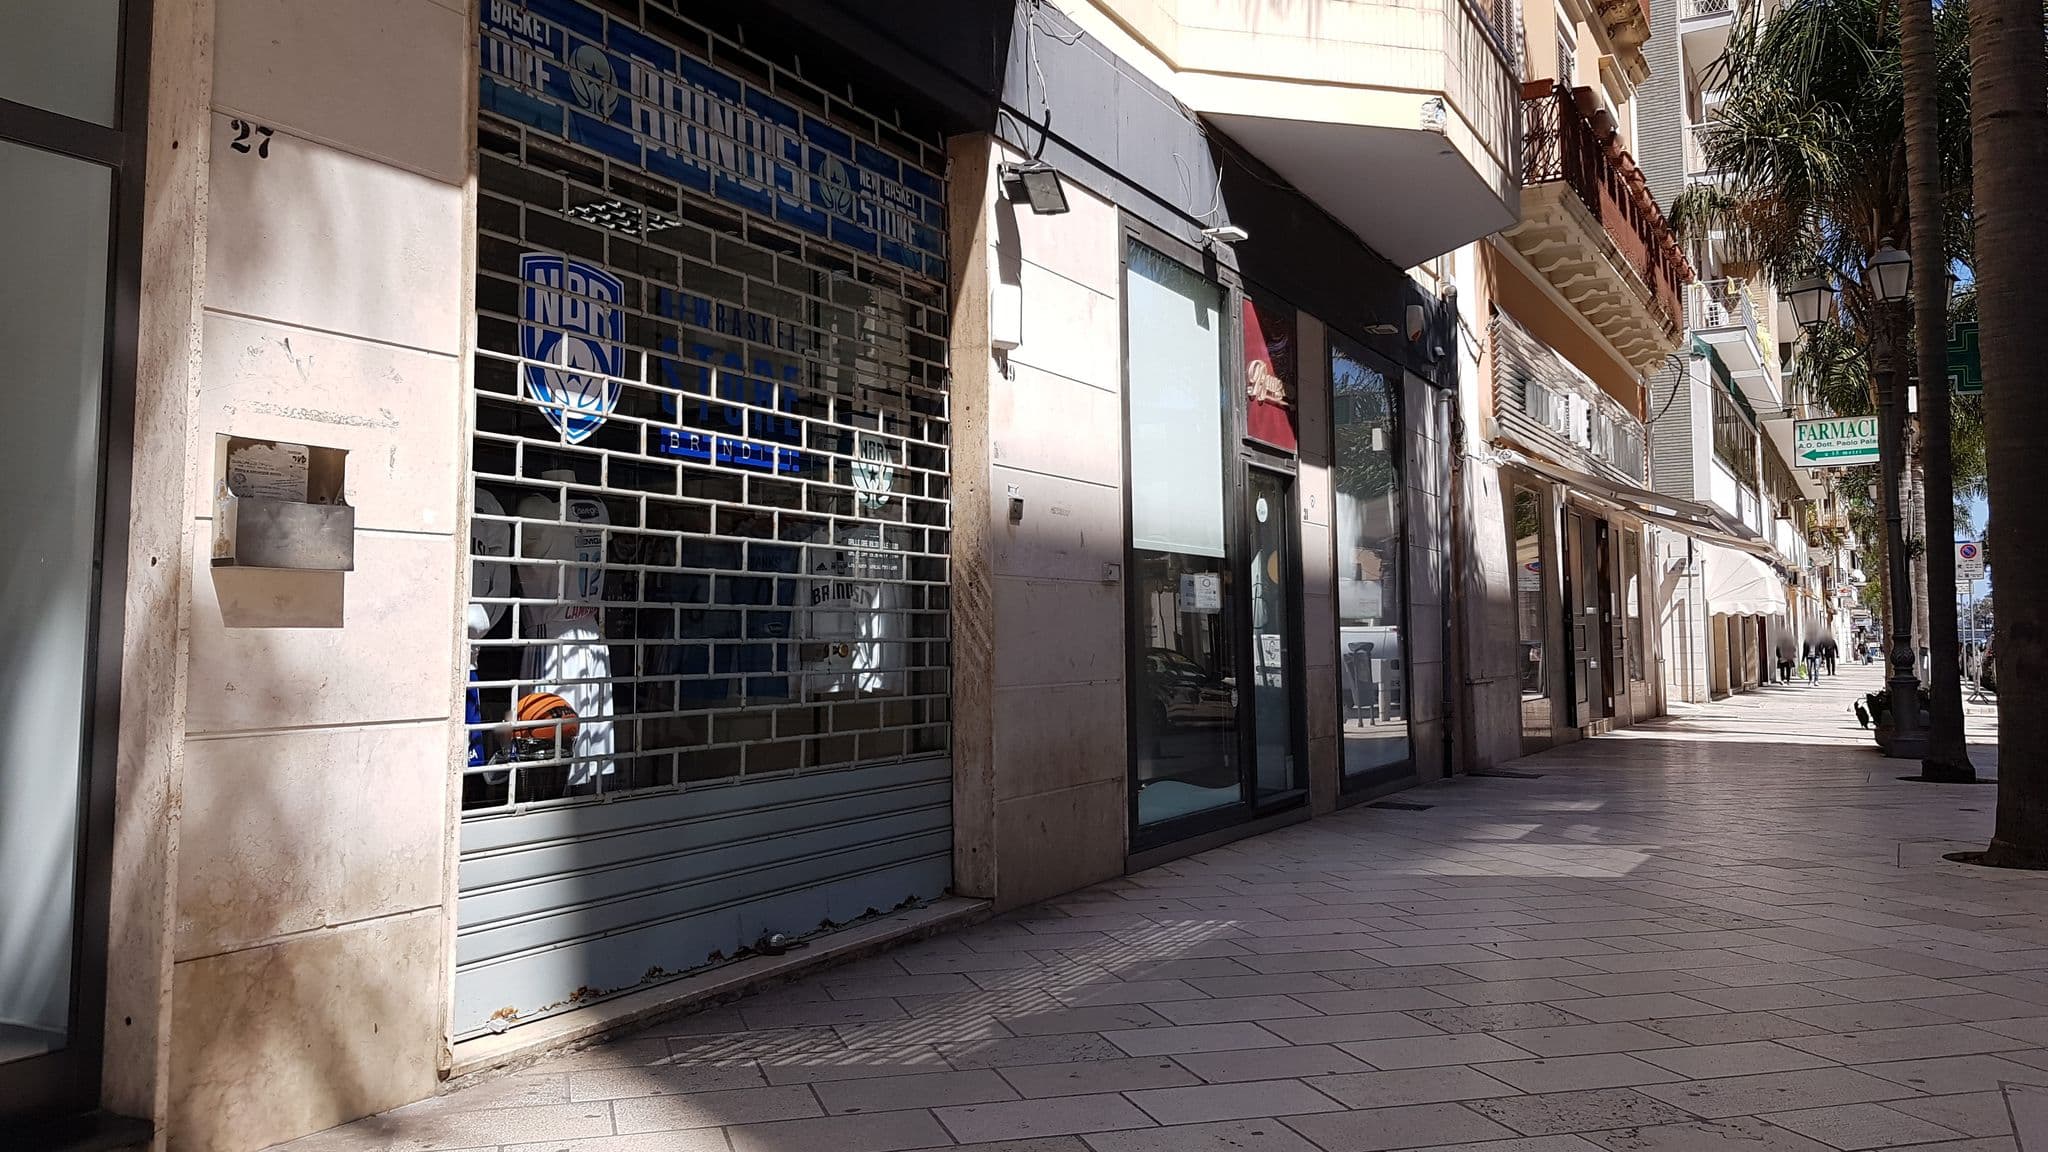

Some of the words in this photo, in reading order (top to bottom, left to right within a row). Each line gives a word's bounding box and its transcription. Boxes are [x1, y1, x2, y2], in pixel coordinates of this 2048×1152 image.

[490, 0, 551, 46] BASKET
[230, 118, 275, 159] 27
[630, 52, 813, 213] BRINDISI
[859, 168, 881, 193] NEW
[884, 178, 916, 209] BASKET
[860, 189, 917, 246] STORE
[534, 267, 611, 336] NBR
[716, 303, 796, 353] BASKET
[659, 336, 800, 438] STORE
[670, 431, 793, 467] BRNDII
[813, 583, 864, 605] BRINDSI
